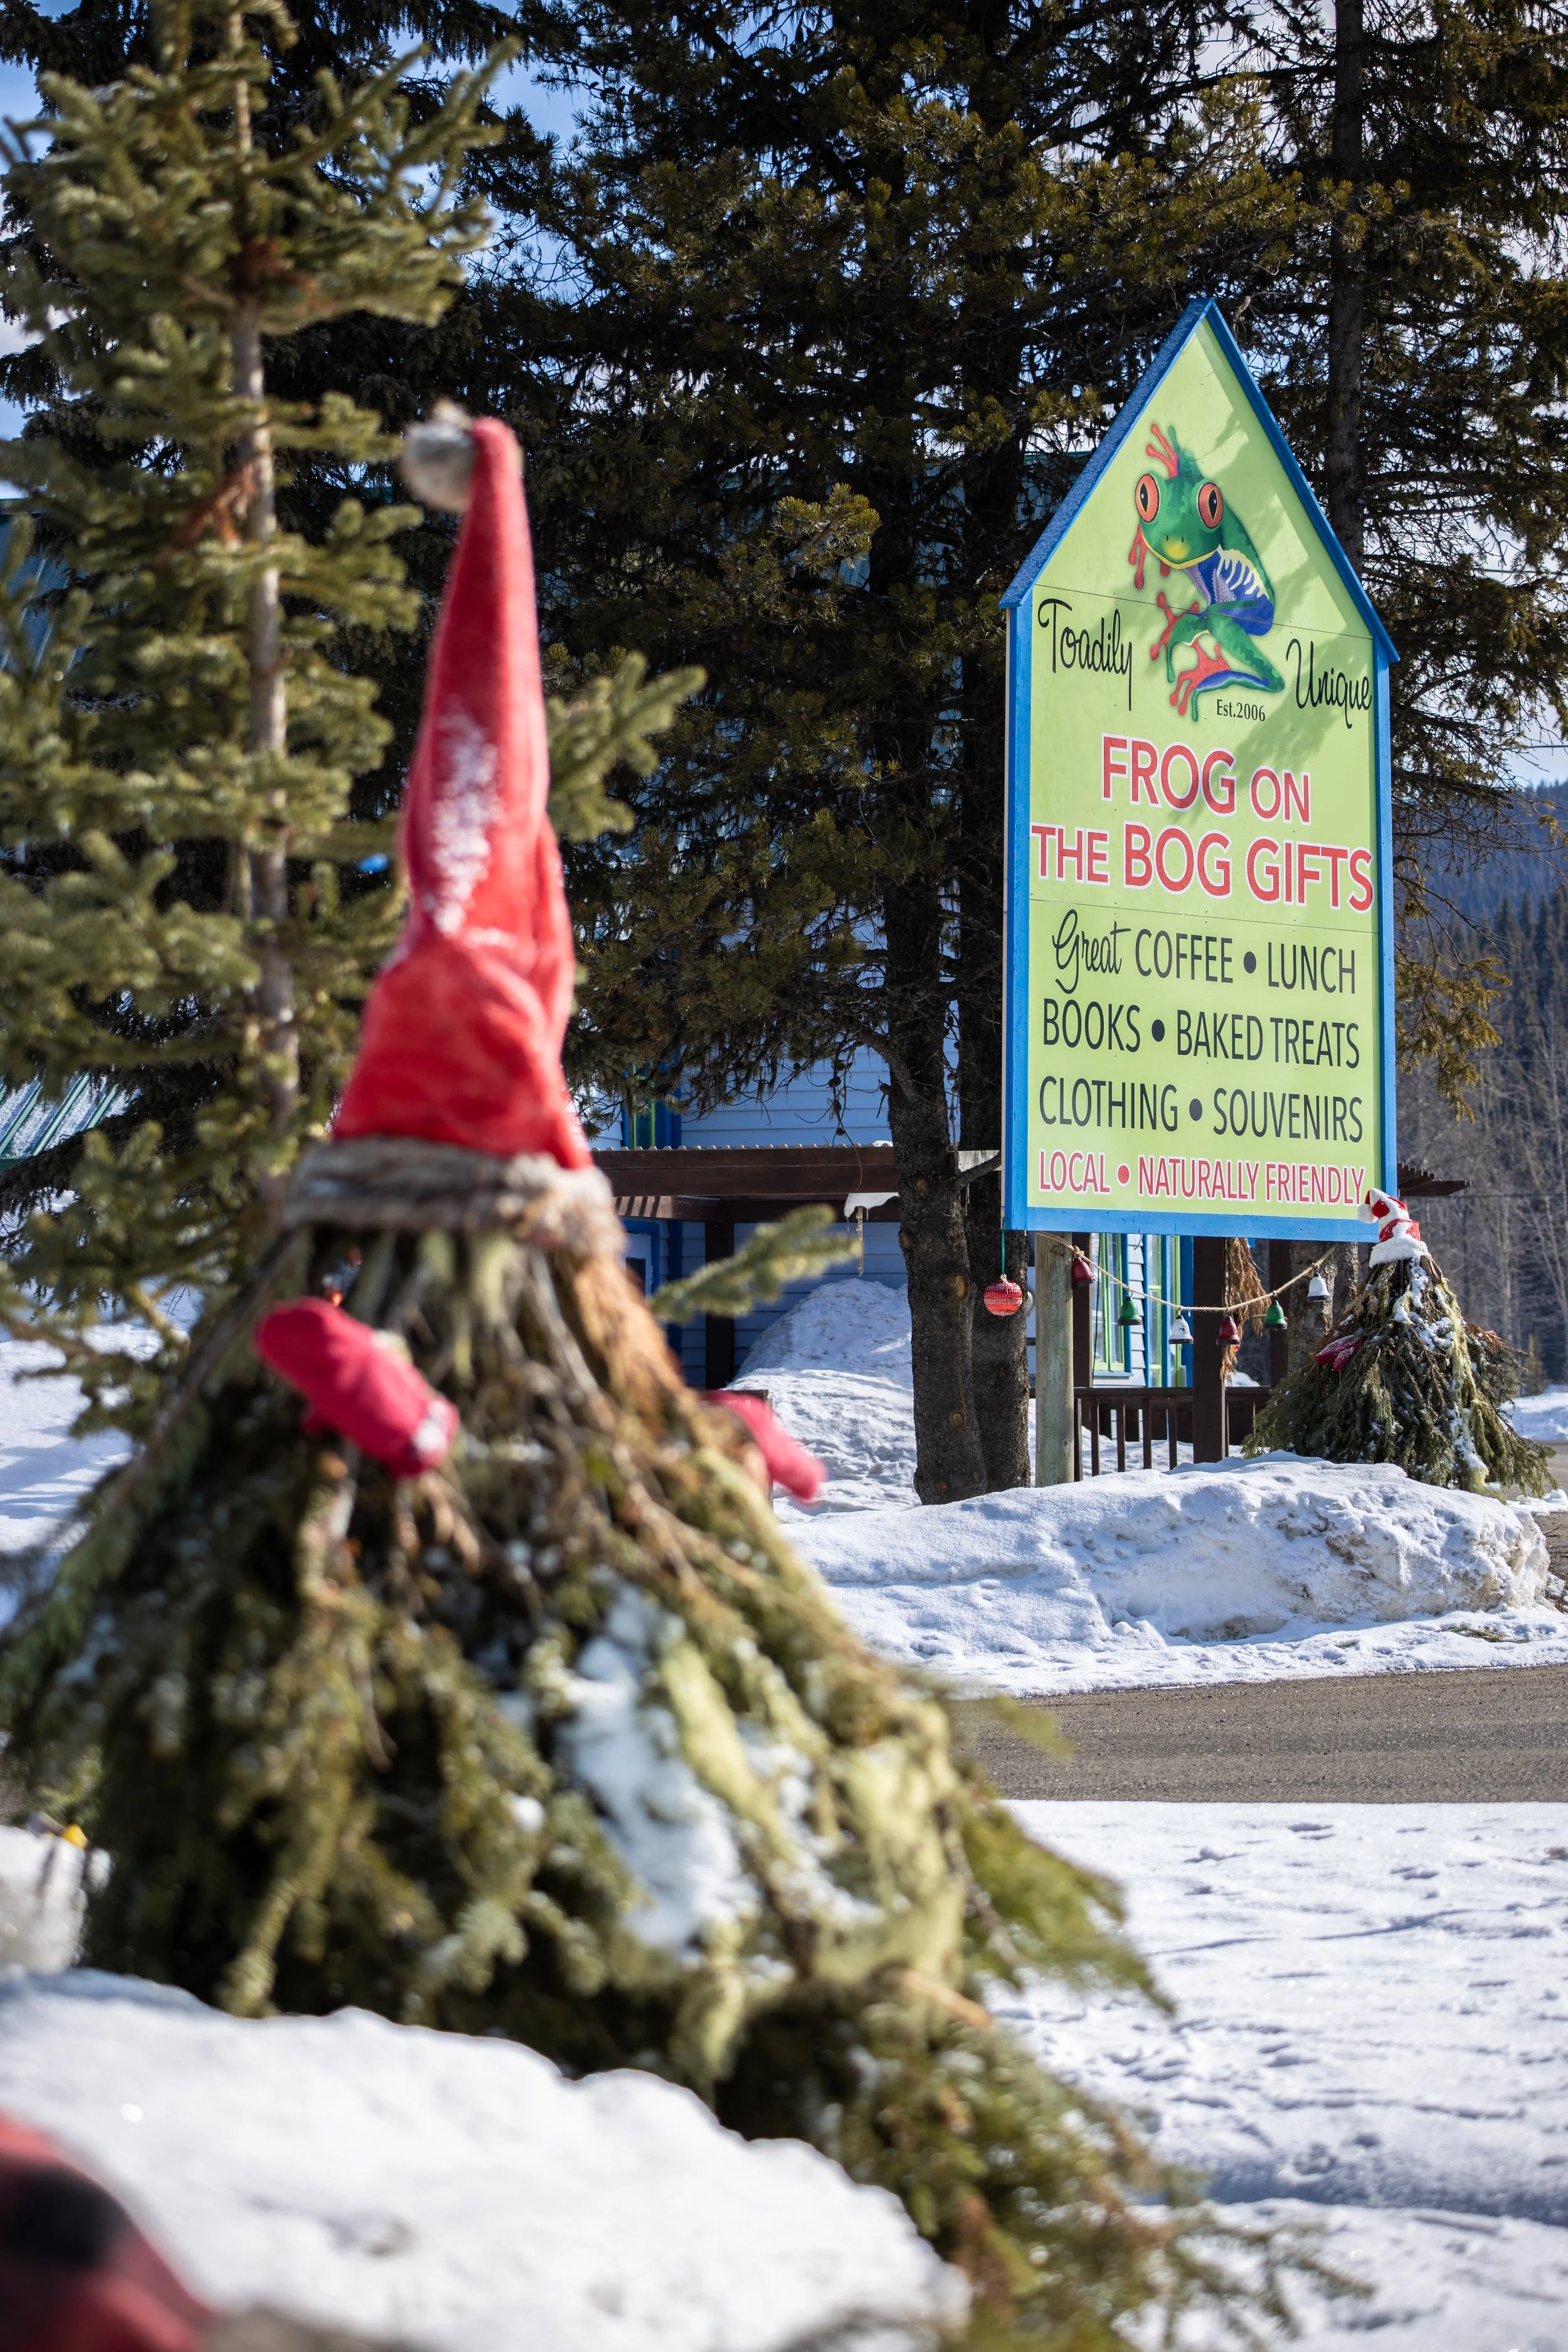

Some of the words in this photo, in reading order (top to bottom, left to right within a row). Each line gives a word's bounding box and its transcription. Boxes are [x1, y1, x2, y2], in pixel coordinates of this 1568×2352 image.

[1038, 598, 1132, 711] Toadily
[1286, 638, 1372, 729] Unique
[1101, 733, 1237, 817] FROG
[1249, 766, 1311, 826] ON
[1029, 822, 1110, 886] THE
[1123, 822, 1232, 899] BOG
[1245, 837, 1374, 914] GIFTS
[1052, 909, 1131, 994] Great
[1135, 928, 1233, 983] COFFEE
[1268, 941, 1355, 994] LUNCH
[1044, 998, 1140, 1052] BOOKS
[1177, 1009, 1263, 1061] BAKED
[1269, 1017, 1360, 1069] TREATS
[1039, 1075, 1178, 1131] CLOTHING
[1213, 1088, 1362, 1143] SOUVENIRS
[1039, 1149, 1111, 1195] LOCAL
[1138, 1154, 1260, 1202] NATURALLY
[1264, 1160, 1365, 1205] FRIENDLY
